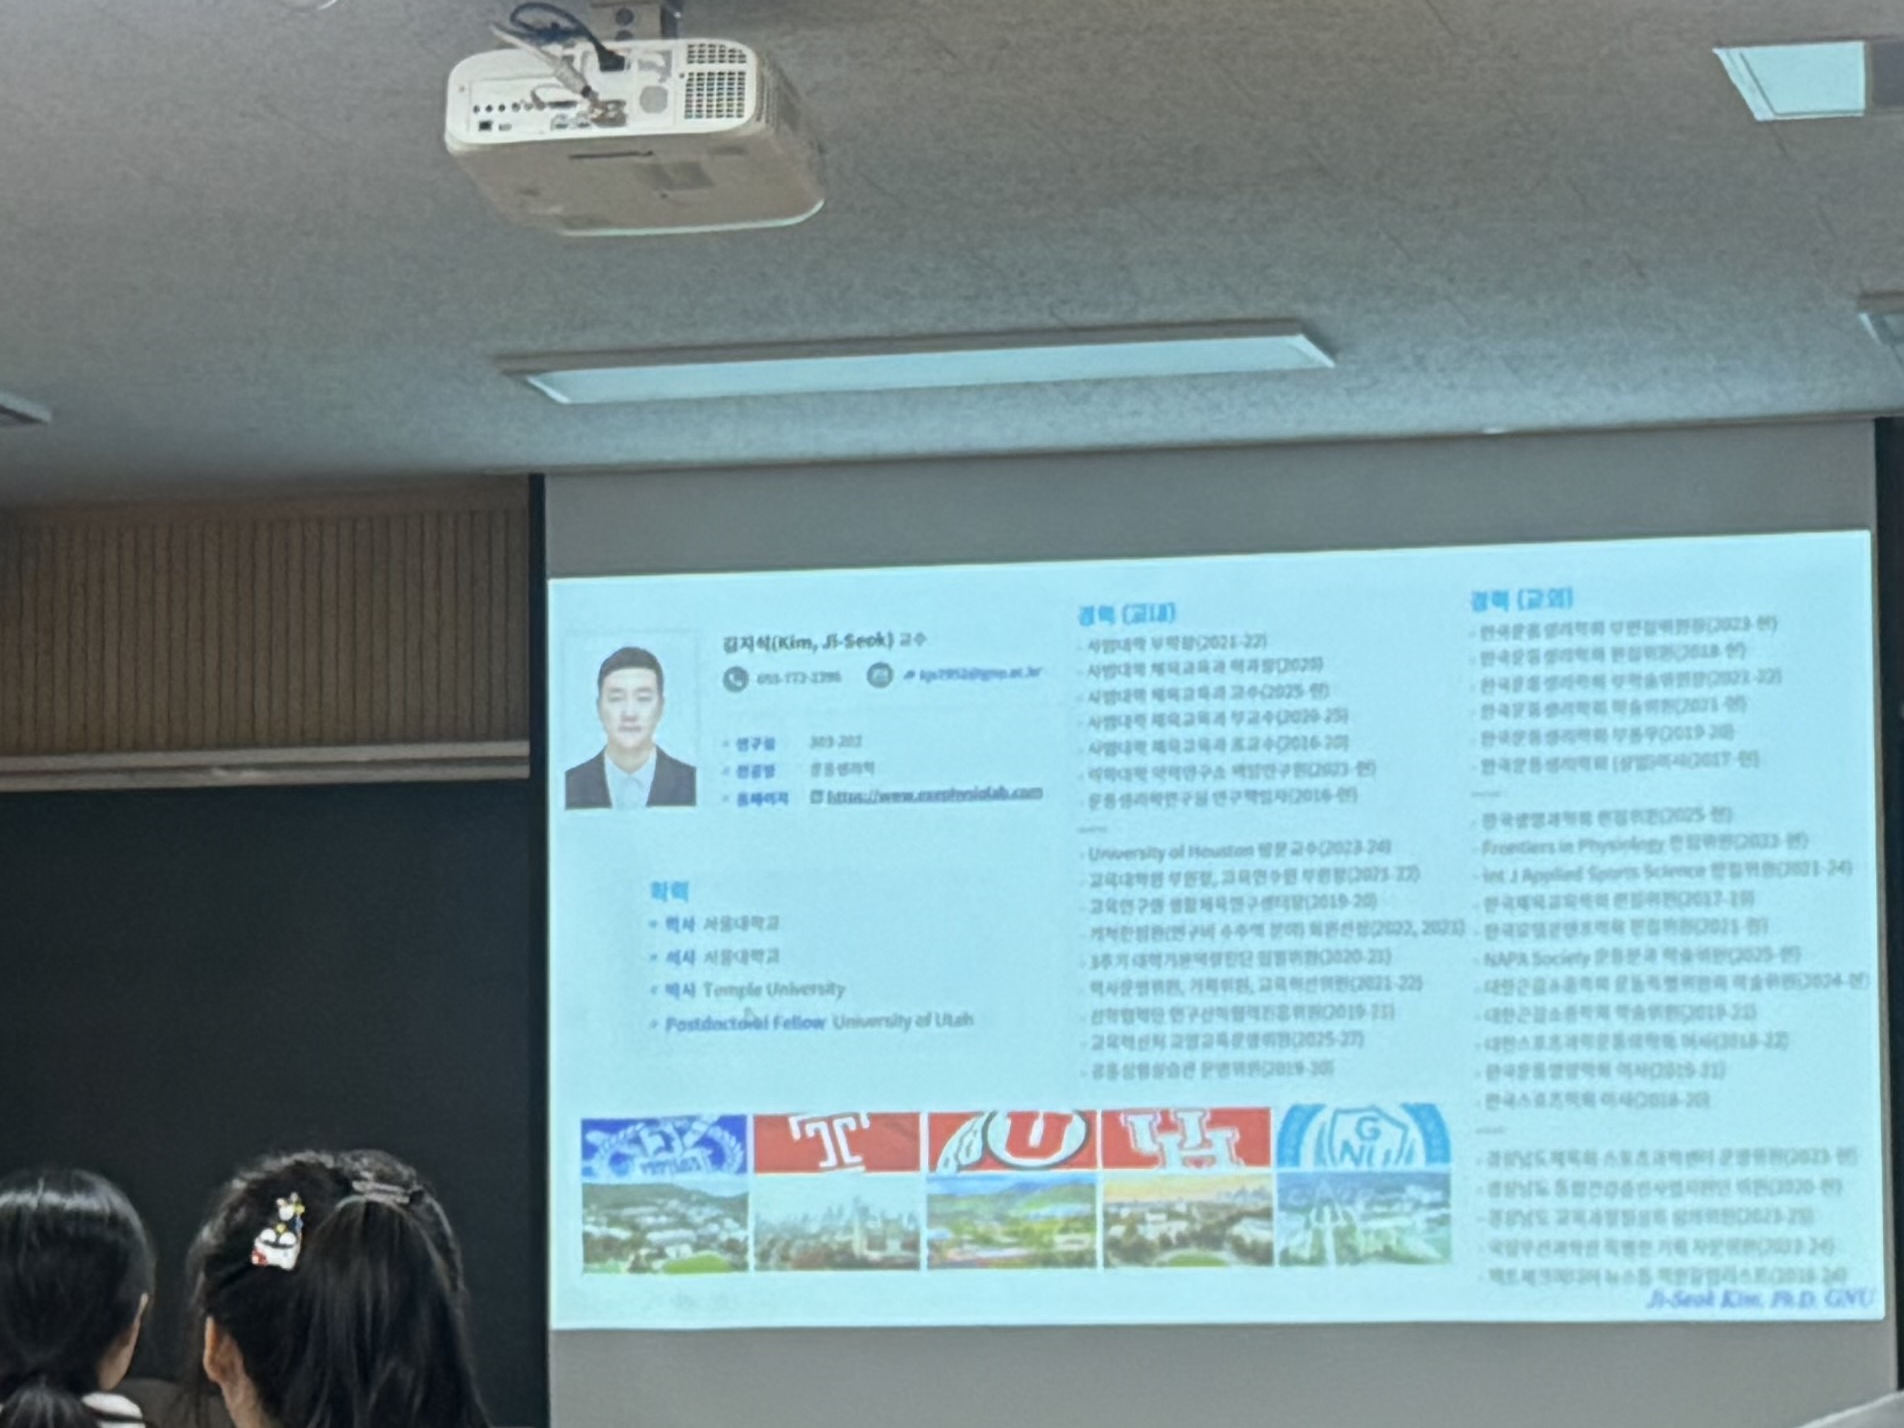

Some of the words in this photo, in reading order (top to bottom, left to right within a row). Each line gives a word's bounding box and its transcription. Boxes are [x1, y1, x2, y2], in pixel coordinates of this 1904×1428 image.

[1087, 847, 1165, 862] University
[1168, 843, 1185, 859] of
[1187, 845, 1254, 858] Houston
[1481, 840, 1556, 856] Frontiers
[1557, 842, 1574, 854] in
[1576, 836, 1665, 855] Physiology
[1531, 951, 1590, 968] Society
[703, 982, 763, 998] Temple
[765, 983, 847, 1000] University
[664, 1016, 769, 1031] Postdoctoral
[772, 1015, 826, 1031] Fellow
[831, 1015, 912, 1029] University
[914, 1012, 932, 1027] of
[934, 1012, 974, 1027] Utah
[1823, 1288, 1875, 1308] GNU
